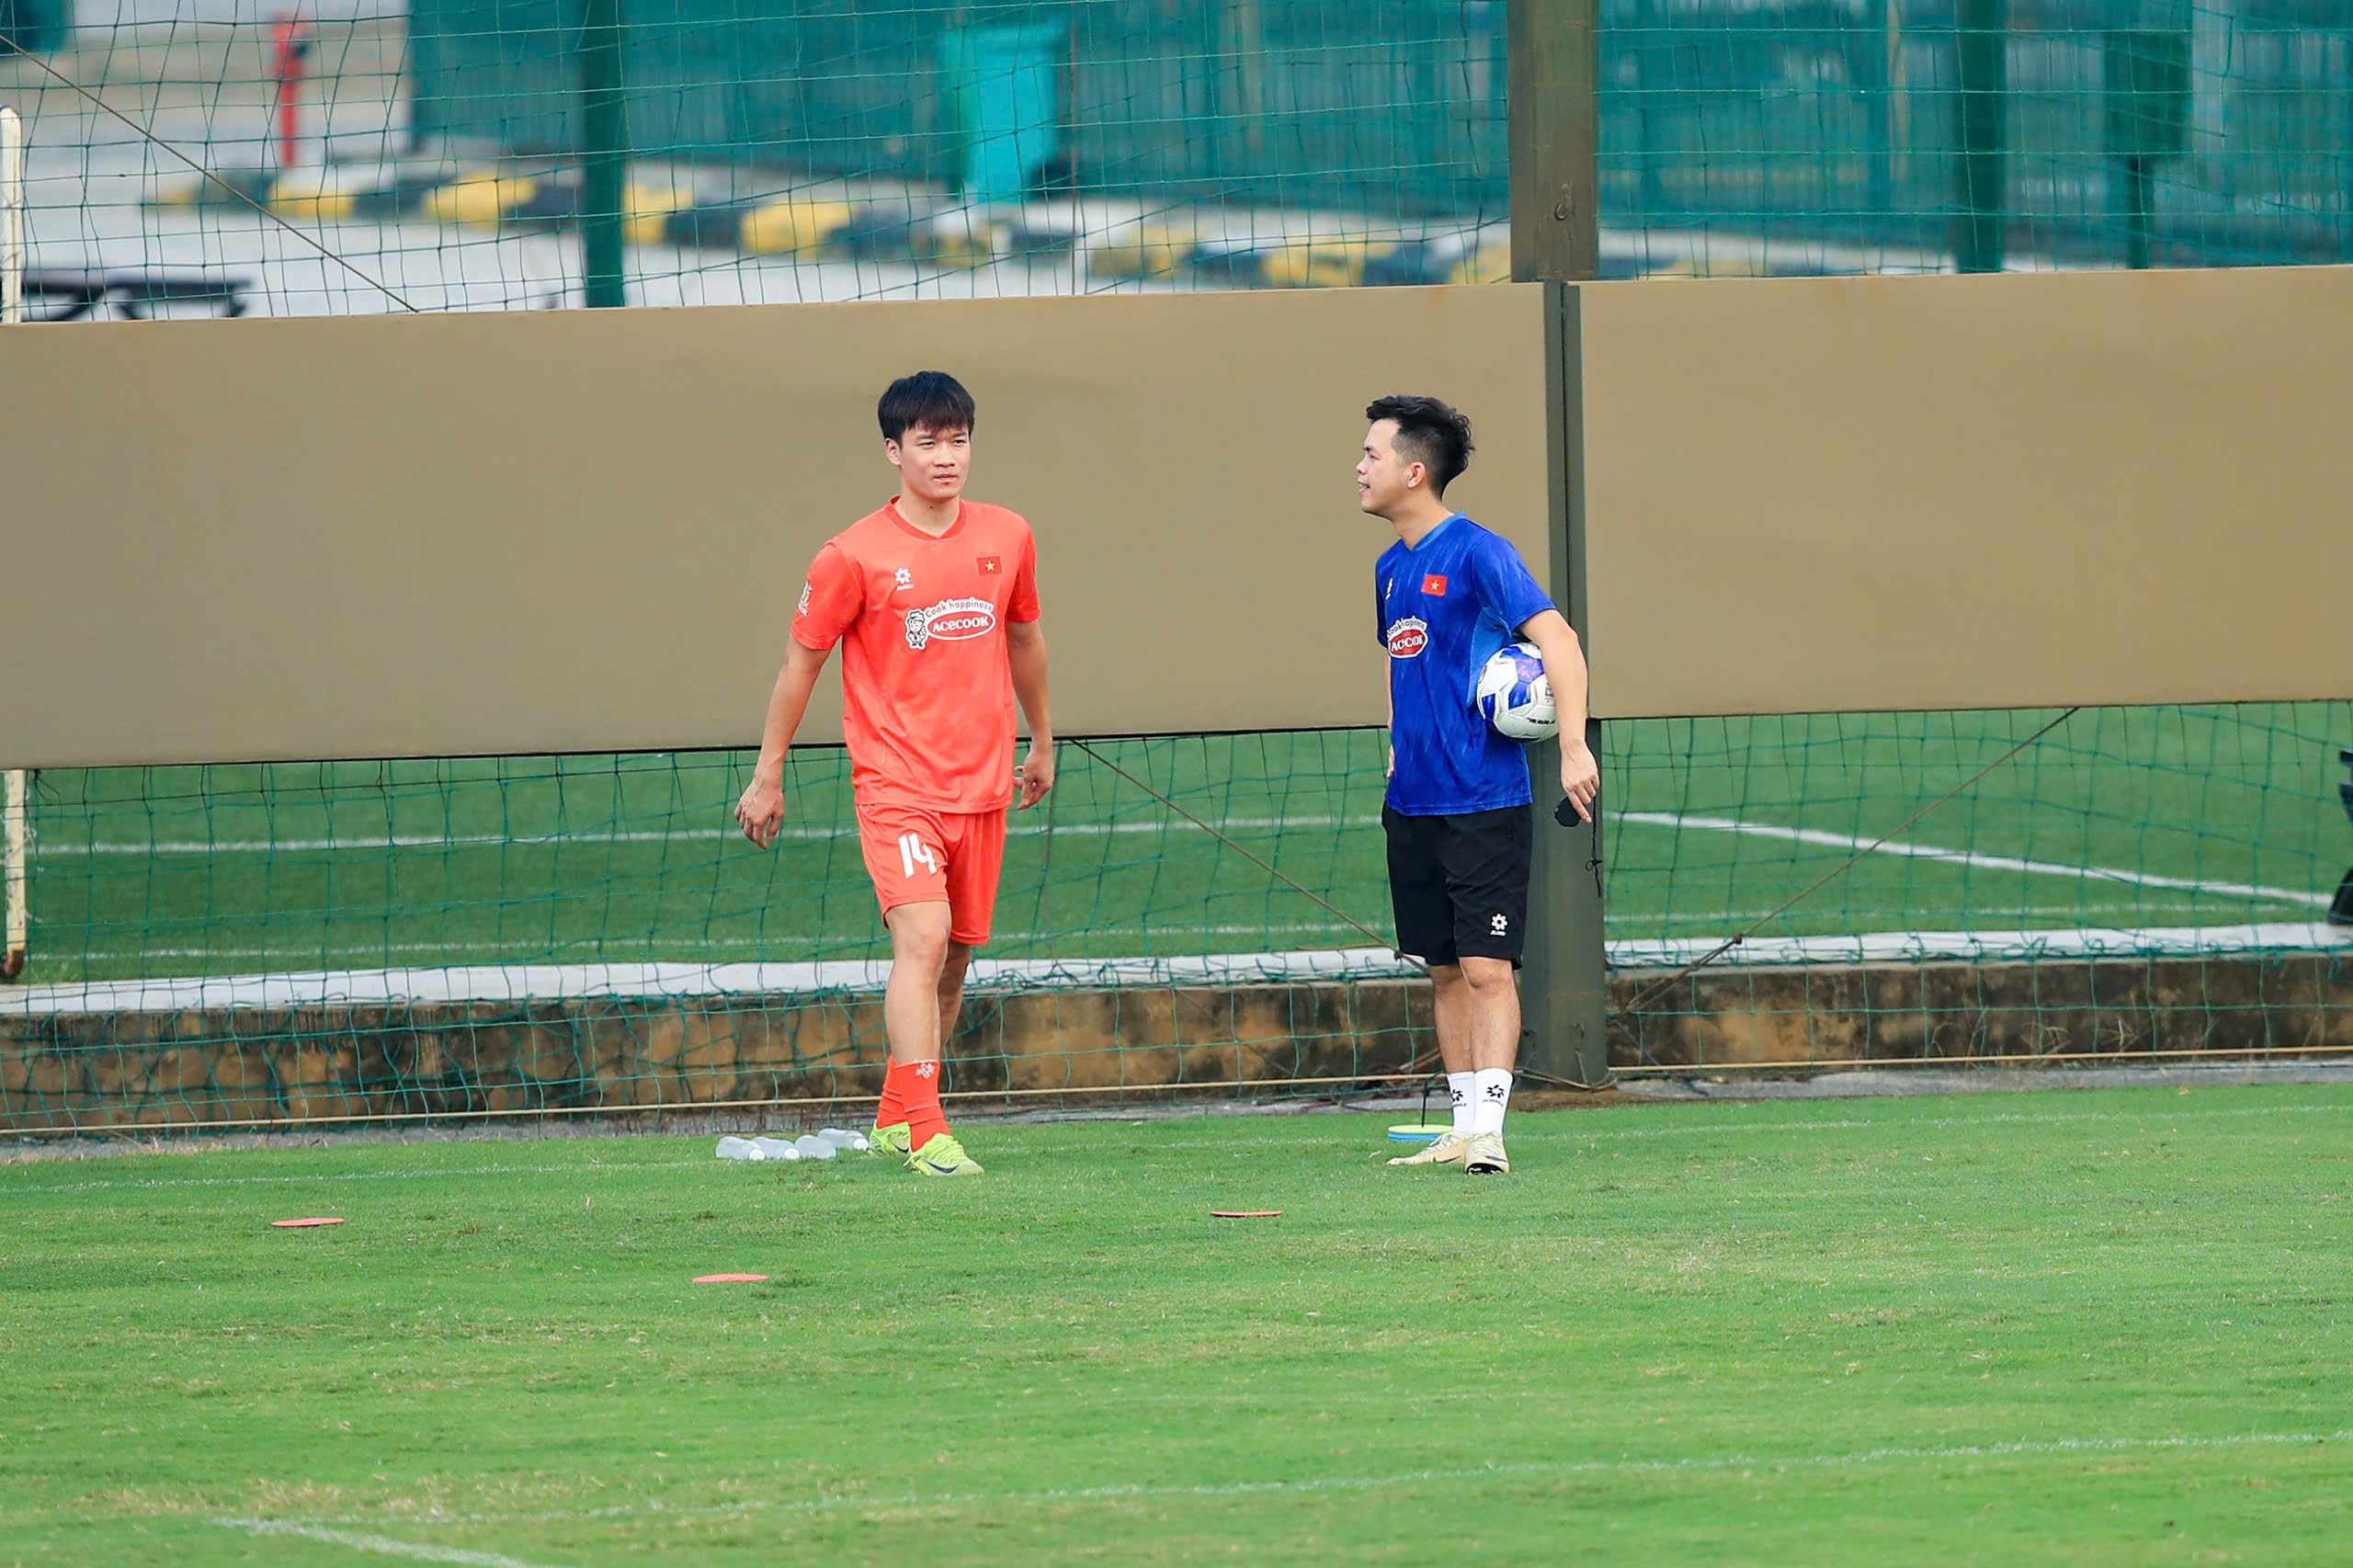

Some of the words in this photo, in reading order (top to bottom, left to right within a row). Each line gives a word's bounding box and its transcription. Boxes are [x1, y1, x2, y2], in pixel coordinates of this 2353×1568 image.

[926, 603, 948, 618] Cook
[949, 601, 993, 611] happiness
[898, 832, 938, 879] 14
